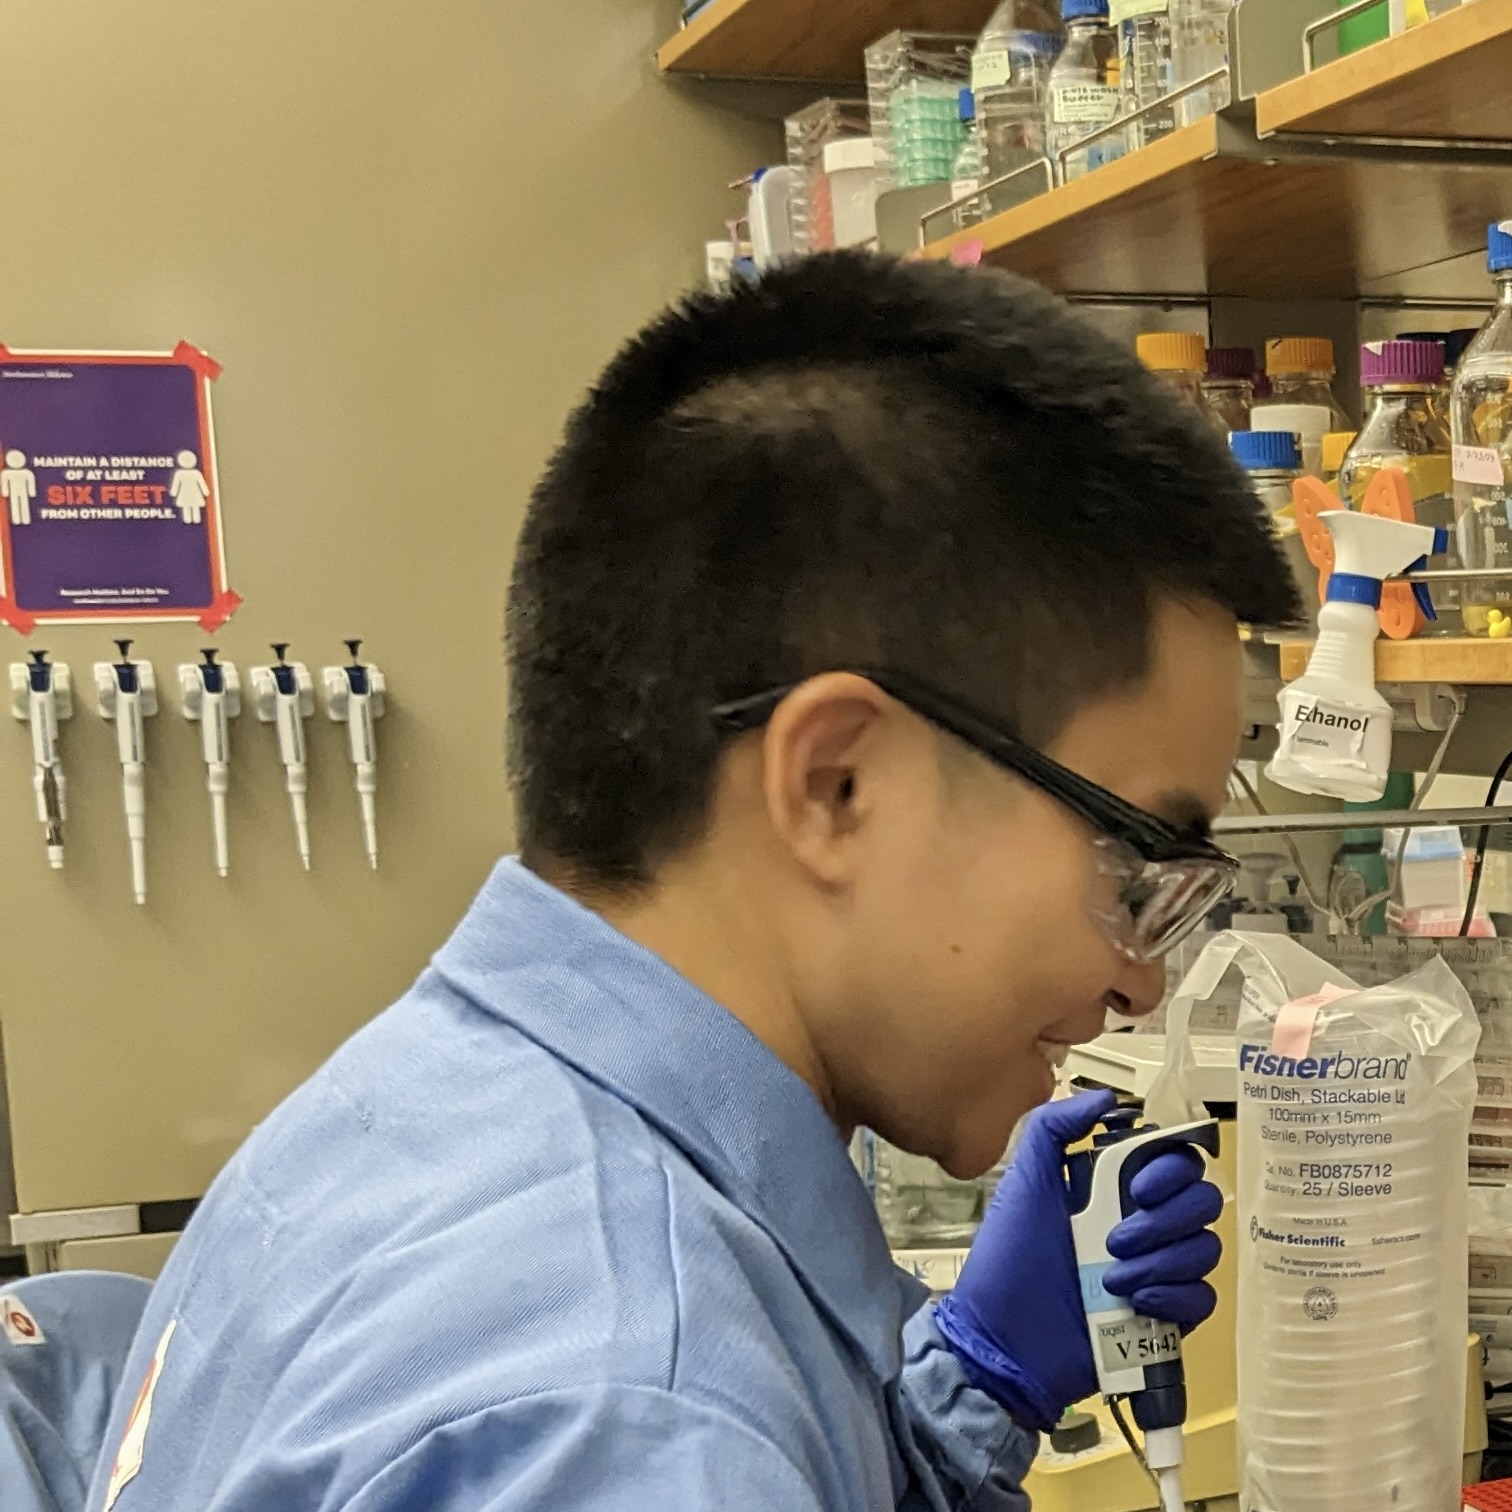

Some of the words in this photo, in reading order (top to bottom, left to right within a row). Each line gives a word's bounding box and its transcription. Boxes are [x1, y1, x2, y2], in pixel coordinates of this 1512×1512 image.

[34, 456, 98, 468] MAINTAIN
[99, 456, 110, 468] A
[111, 456, 175, 468] DISTANCE
[65, 470, 84, 481] OF
[86, 470, 103, 481] AT
[105, 470, 145, 481] LEAST
[46, 485, 94, 505] SIX
[101, 485, 167, 505] FEET
[41, 508, 79, 520] FROM
[79, 508, 124, 520] OTHER
[125, 508, 176, 520] PEOPLE.
[1295, 704, 1370, 733] Ethanol
[1243, 1081, 1267, 1100] Petri
[1271, 1085, 1306, 1105] Dish,
[1310, 1088, 1391, 1104] Stackable
[1269, 1108, 1316, 1123] 100mm
[1321, 1113, 1330, 1123] x
[1336, 1111, 1382, 1125] 15mm
[1261, 1126, 1301, 1145] Sterile,
[1305, 1130, 1393, 1148] Polystyrene
[1300, 1163, 1393, 1179] FB0875712
[1302, 1181, 1323, 1196] 25
[1326, 1183, 1334, 1197] /
[1337, 1182, 1392, 1197] Sleeve
[1258, 1227, 1286, 1244] Fisher
[1287, 1234, 1347, 1248] Scientific
[1329, 1260, 1344, 1268] use
[1116, 1340, 1131, 1360] V
[1138, 1332, 1178, 1358] 5642
